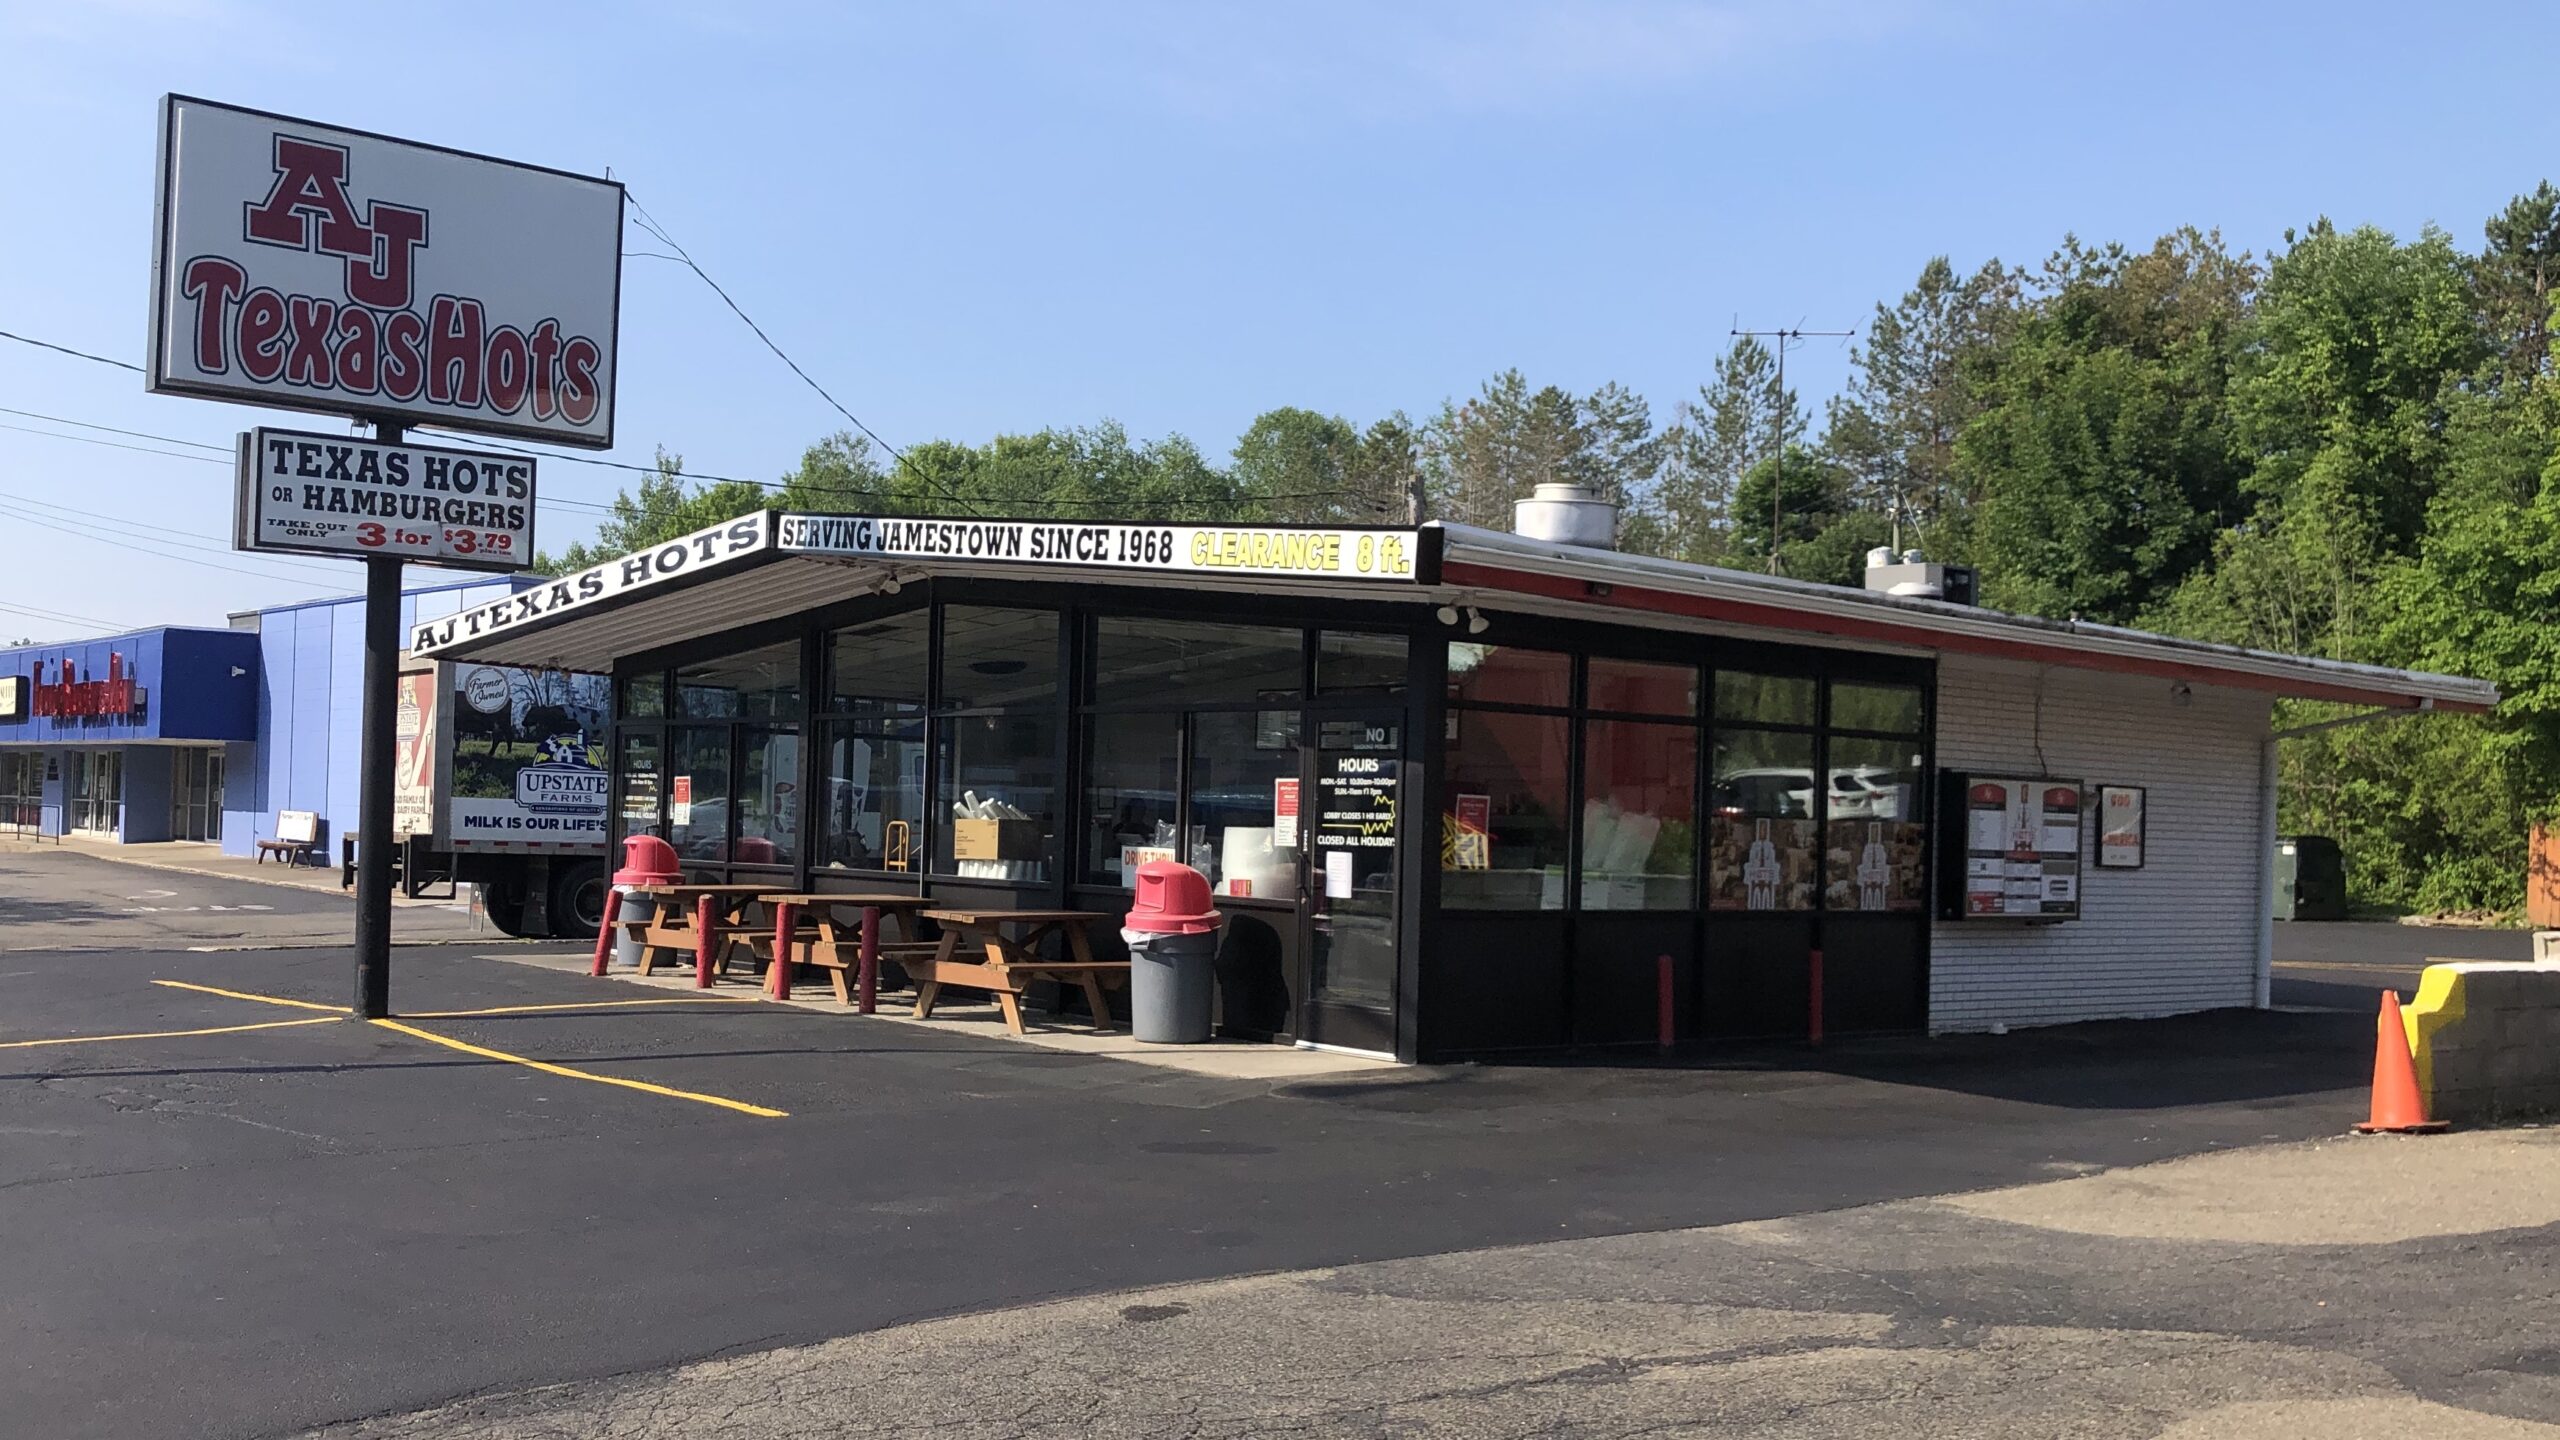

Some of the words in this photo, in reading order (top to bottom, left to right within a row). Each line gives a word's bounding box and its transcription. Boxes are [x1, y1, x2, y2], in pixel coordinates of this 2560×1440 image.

[243, 133, 429, 311] AJ
[269, 440, 410, 487] TEXAS
[424, 456, 528, 500] HOTS
[272, 486, 293, 502] OR
[303, 484, 525, 531] HAMBURGERS
[267, 518, 310, 529] TAKE
[315, 522, 348, 531] OUT
[286, 528, 329, 538] ONLY
[356, 522, 387, 547] 3
[395, 529, 432, 546] for
[444, 529, 512, 554] $3.79
[783, 518, 872, 550] SERVING
[876, 522, 1024, 557] JAMESTOWN
[1030, 527, 1109, 561] SINCE
[1117, 529, 1173, 563] 1968
[1190, 531, 1341, 571] CLEARANCE
[1356, 535, 1374, 572] 8
[414, 619, 457, 652] AJ
[465, 569, 604, 636] TEXAS
[621, 517, 760, 588] HOTS
[470, 677, 503, 695] Farmer
[474, 687, 506, 704] Owned
[1366, 728, 1386, 742] NO
[1338, 758, 1380, 772] HOURS
[525, 773, 608, 794] UPSTATE
[540, 793, 593, 803] FARMS
[464, 815, 503, 829] MILK
[507, 817, 522, 829] IS
[525, 817, 559, 830] OUR
[1341, 812, 1362, 820] CLOSES
[1317, 834, 1346, 846] CLOSED
[1346, 835, 1360, 847] ALL
